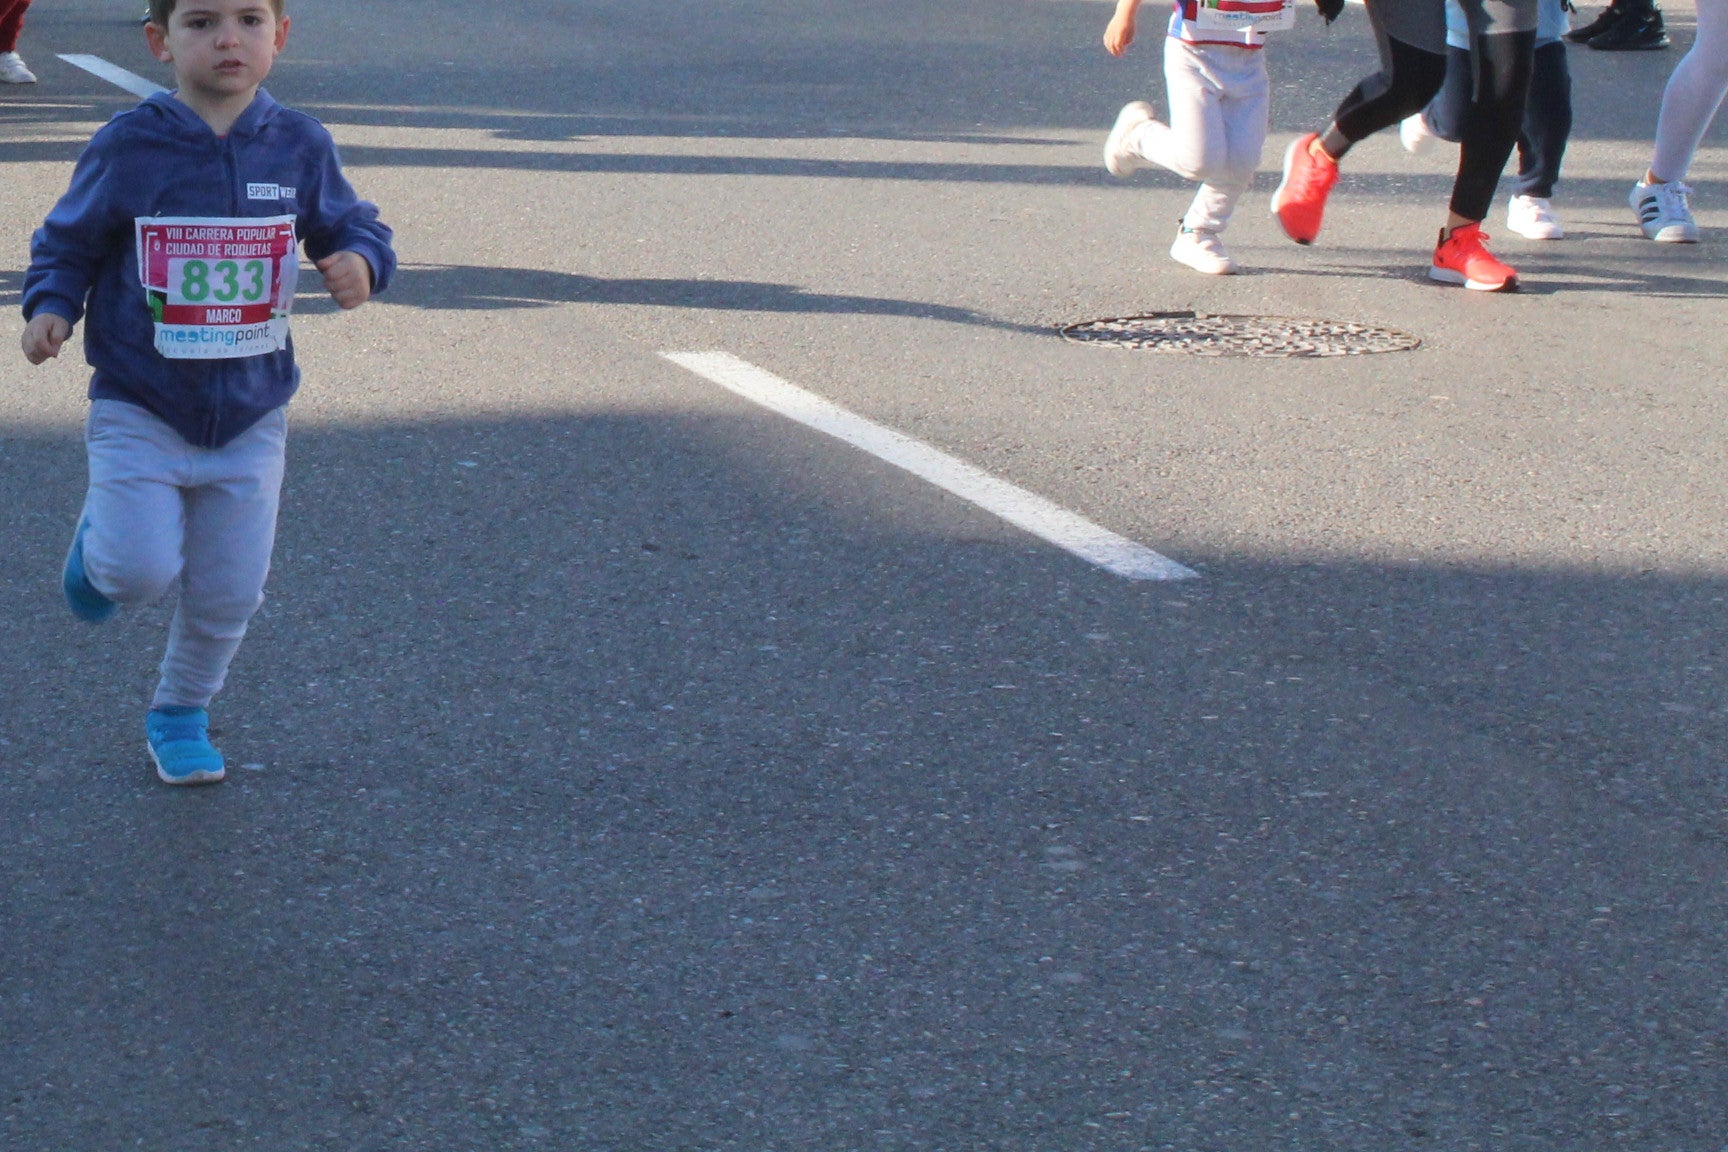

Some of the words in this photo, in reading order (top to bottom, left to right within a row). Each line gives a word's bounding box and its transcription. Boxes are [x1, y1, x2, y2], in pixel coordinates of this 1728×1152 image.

[249, 185, 277, 197] SPORT
[166, 228, 183, 240] VIII
[185, 228, 234, 240] CARRERA
[236, 227, 276, 240] POPULAR
[166, 242, 204, 255] CIUDAD
[207, 243, 221, 256] DE
[224, 242, 272, 256] ROQUETAS
[181, 259, 265, 302] 833
[206, 308, 242, 323] MARCO
[160, 323, 271, 346] meetingpoint
